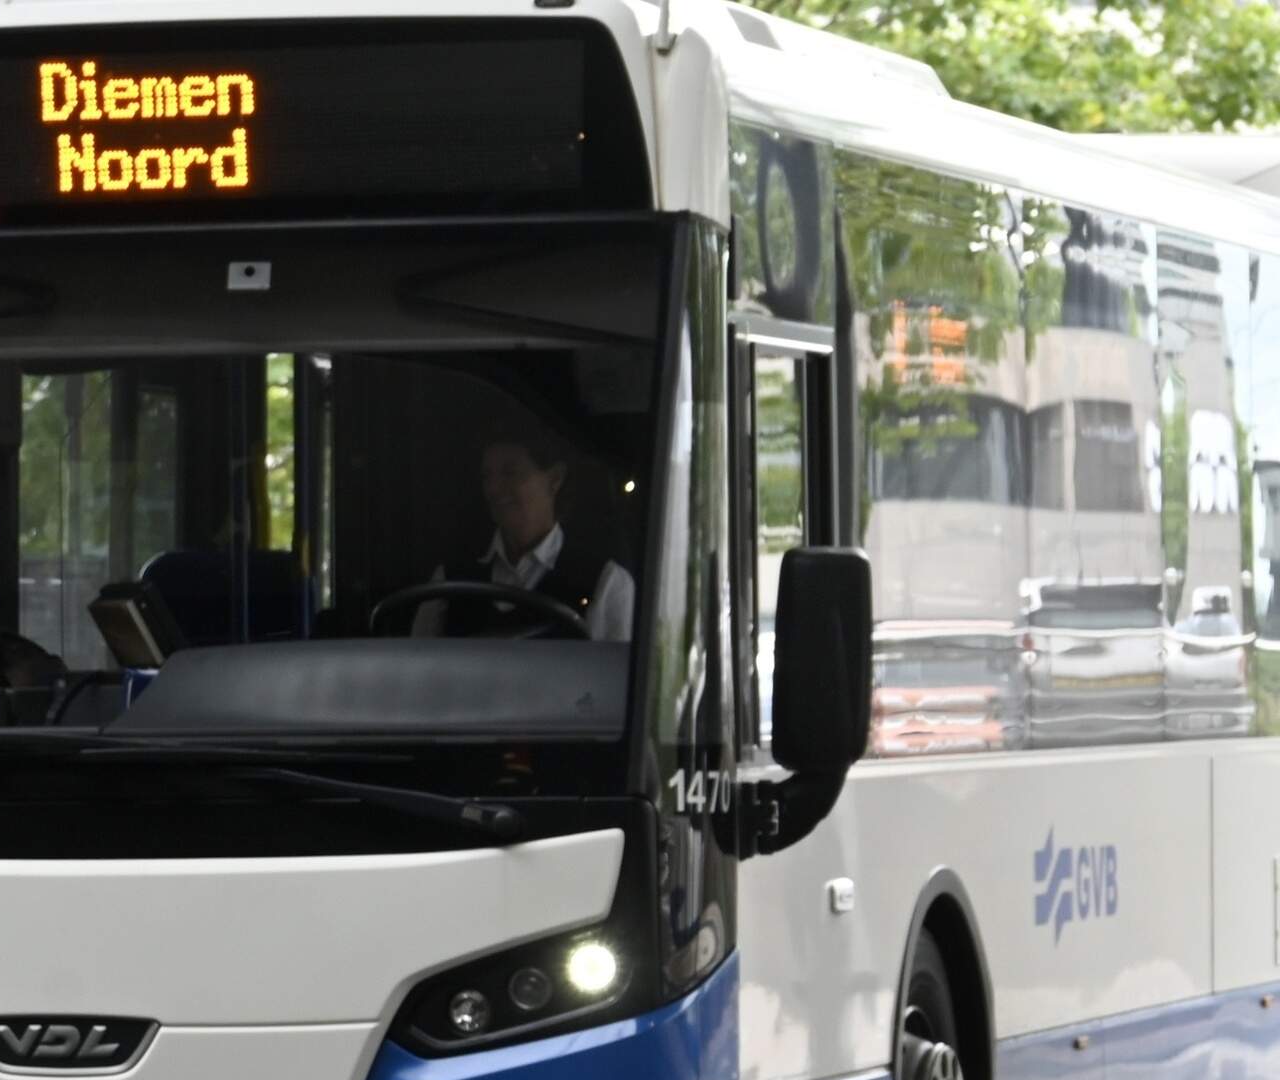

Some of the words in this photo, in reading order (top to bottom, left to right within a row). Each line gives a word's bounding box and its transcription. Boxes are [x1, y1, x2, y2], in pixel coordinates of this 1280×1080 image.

[40, 60, 255, 122] Diemen
[57, 127, 249, 192] Noord
[668, 768, 731, 814] 1470
[1076, 844, 1118, 920] GVB
